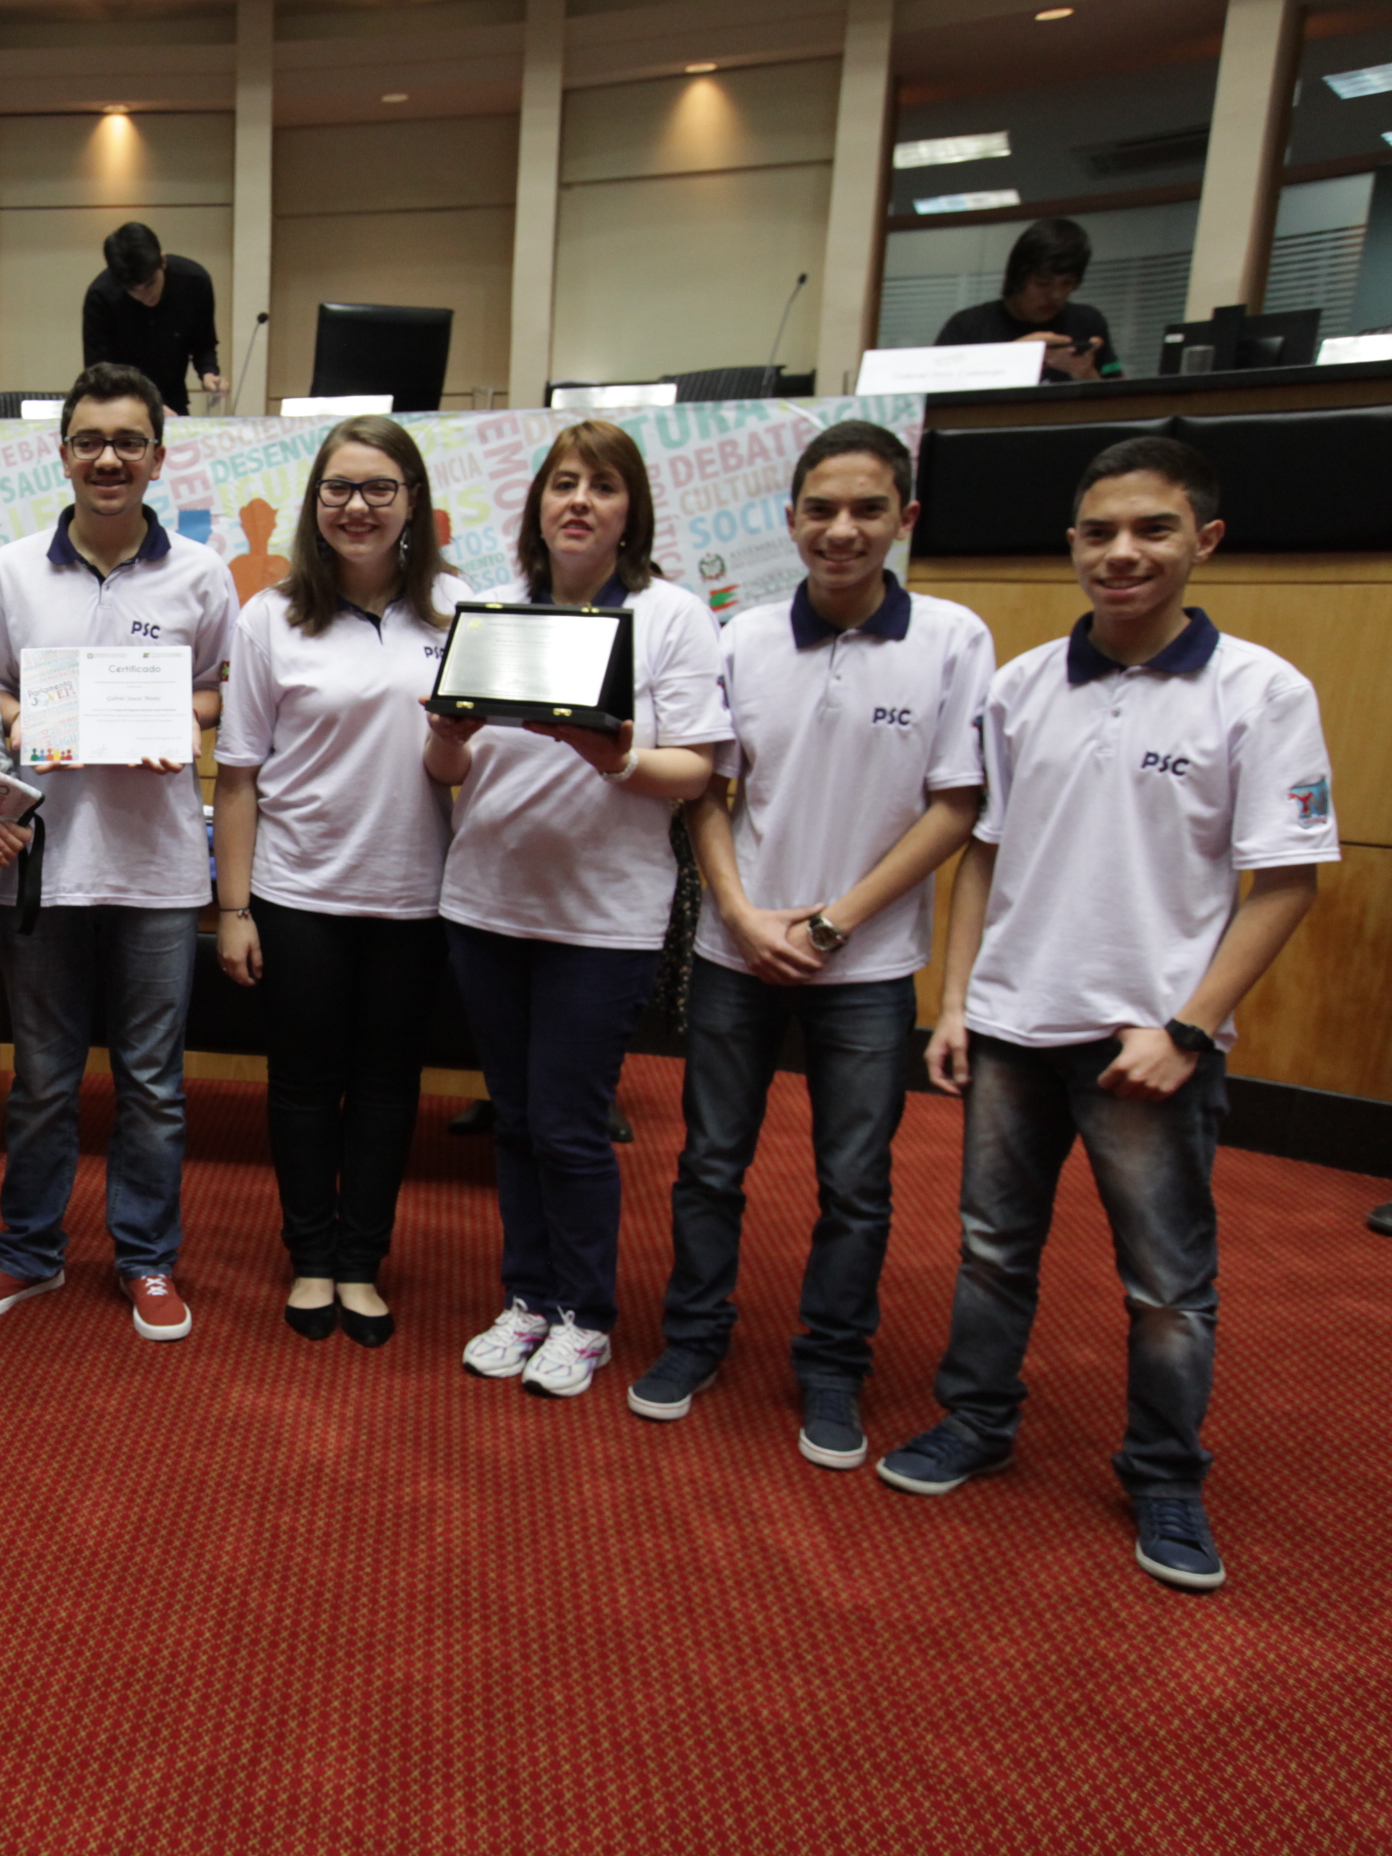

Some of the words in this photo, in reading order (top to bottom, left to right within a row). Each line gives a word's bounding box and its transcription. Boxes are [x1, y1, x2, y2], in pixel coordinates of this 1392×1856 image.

[209, 425, 335, 484] DESENVO
[668, 417, 814, 489] DEBATE
[0, 460, 69, 503] SAÚD
[130, 620, 161, 640] PSC
[108, 664, 161, 673] Certificado
[27, 680, 73, 698] Parlamento
[871, 706, 912, 726] PSC
[1140, 751, 1191, 777] PSC
